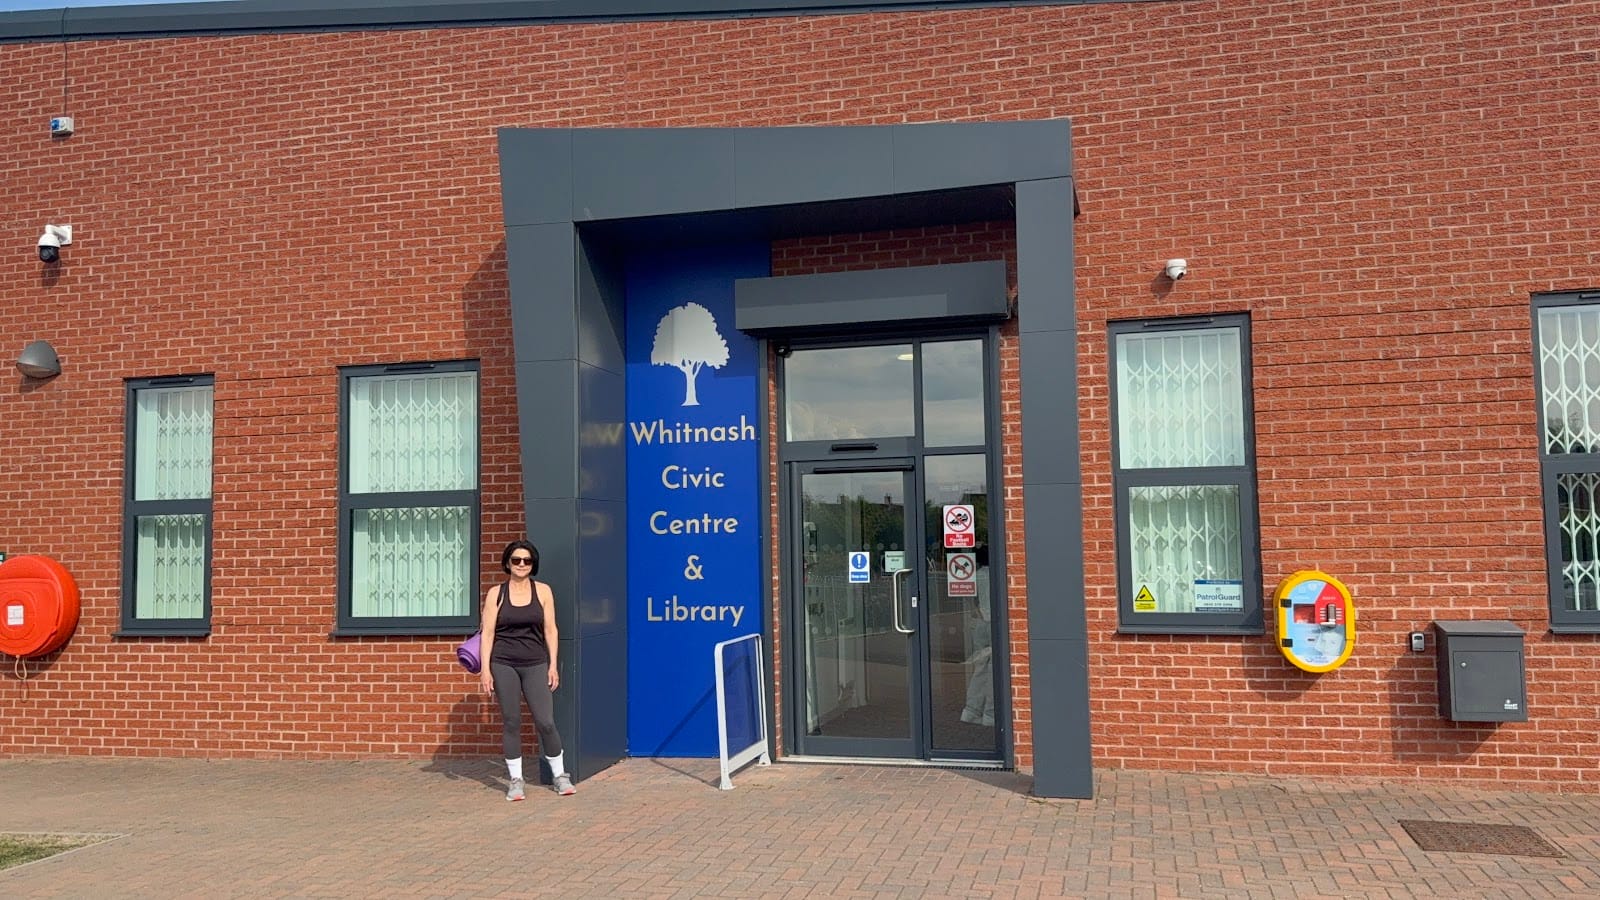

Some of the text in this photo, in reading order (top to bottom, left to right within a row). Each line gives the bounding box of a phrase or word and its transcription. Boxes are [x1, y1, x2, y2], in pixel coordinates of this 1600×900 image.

[629, 415, 755, 446] Whitnash
[661, 465, 725, 489] Civic
[650, 510, 738, 535] Centre
[684, 554, 704, 580] &
[1196, 593, 1241, 601] PatrolGuard
[647, 595, 744, 627] Library
